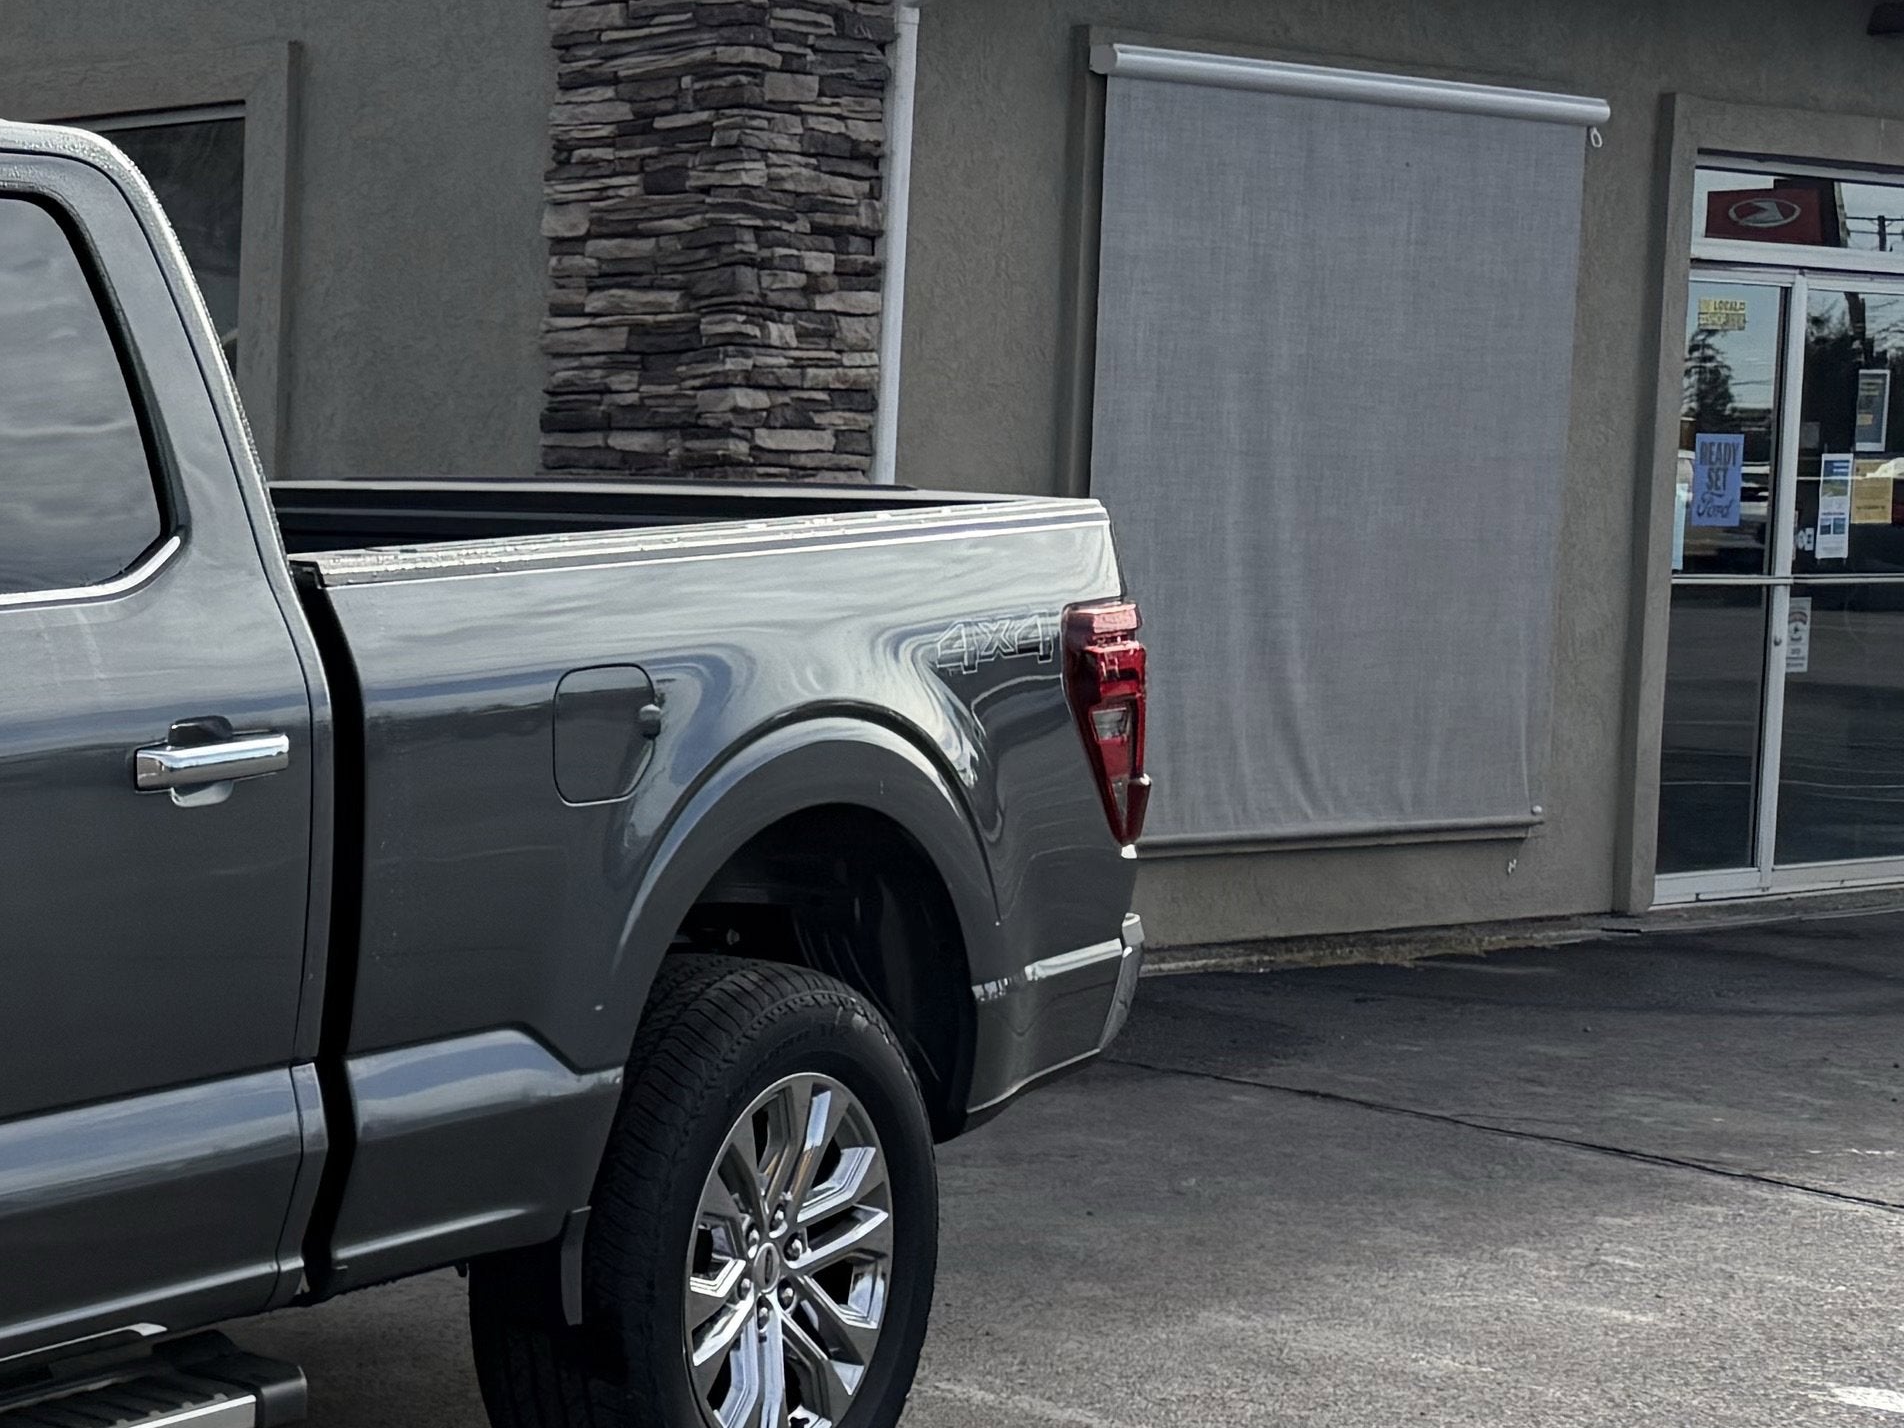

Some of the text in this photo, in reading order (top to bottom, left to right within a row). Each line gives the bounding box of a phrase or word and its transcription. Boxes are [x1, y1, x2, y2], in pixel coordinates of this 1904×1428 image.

[1699, 441, 1740, 467] READY
[1706, 467, 1729, 491] SET
[1697, 492, 1734, 519] Ford
